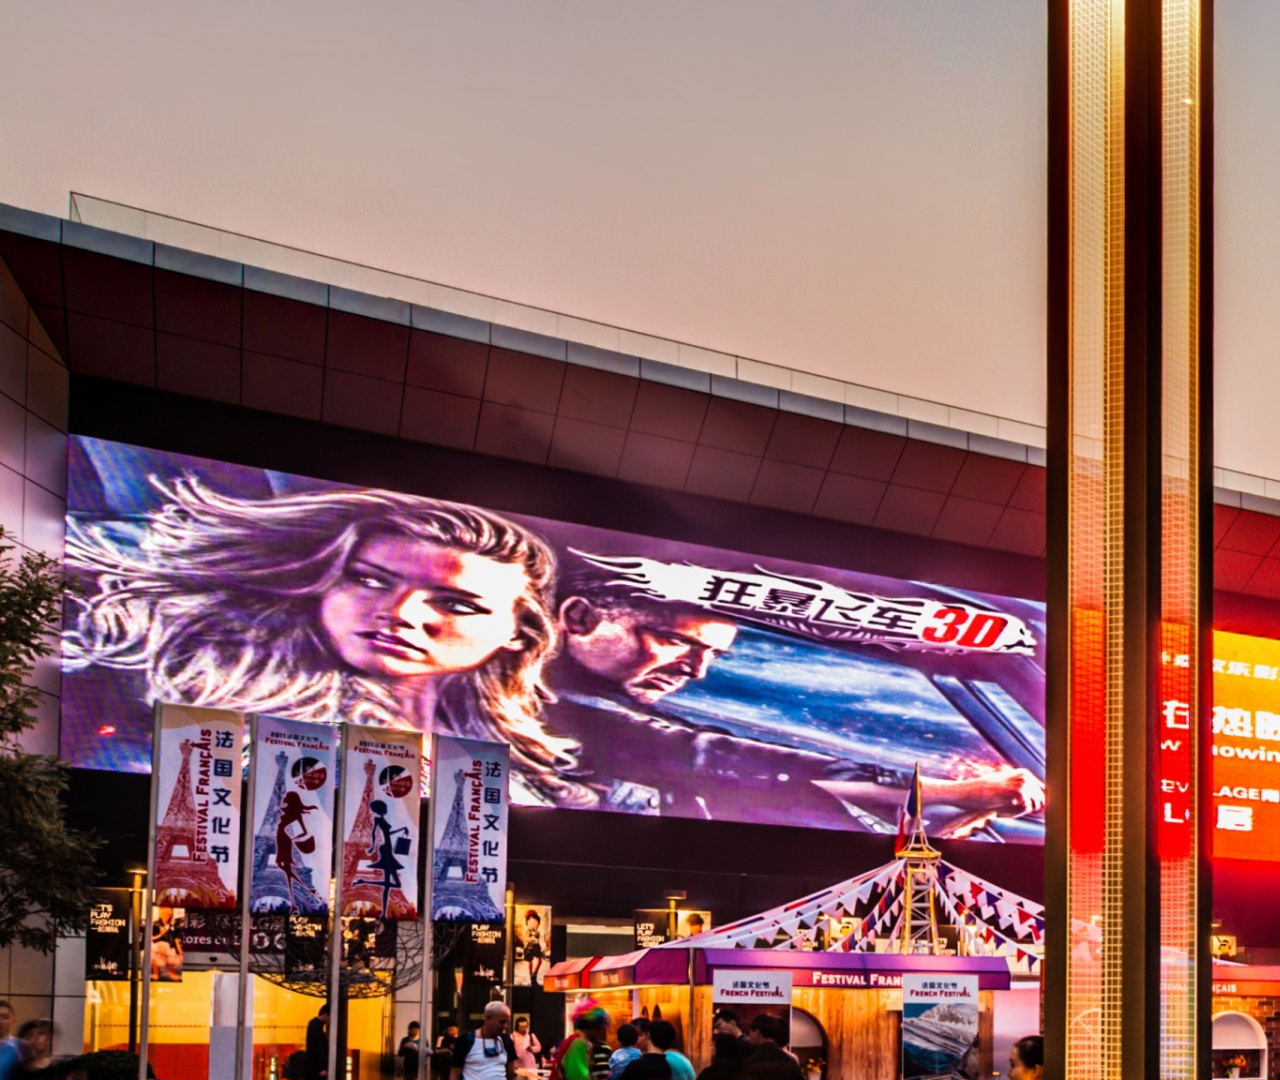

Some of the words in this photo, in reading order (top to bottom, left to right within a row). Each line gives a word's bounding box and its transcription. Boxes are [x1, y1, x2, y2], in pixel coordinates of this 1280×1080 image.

[211, 730, 234, 864] 法国文化节
[482, 761, 502, 884] 法国文化节
[90, 911, 111, 919] PLAY
[90, 919, 126, 927] FASHION
[811, 971, 867, 986] FESTIVAL
[720, 988, 749, 997] FRENCH
[750, 986, 784, 998] FESTIVAL
[909, 989, 938, 997] FRENCH
[939, 987, 971, 998] FESTIVAL
